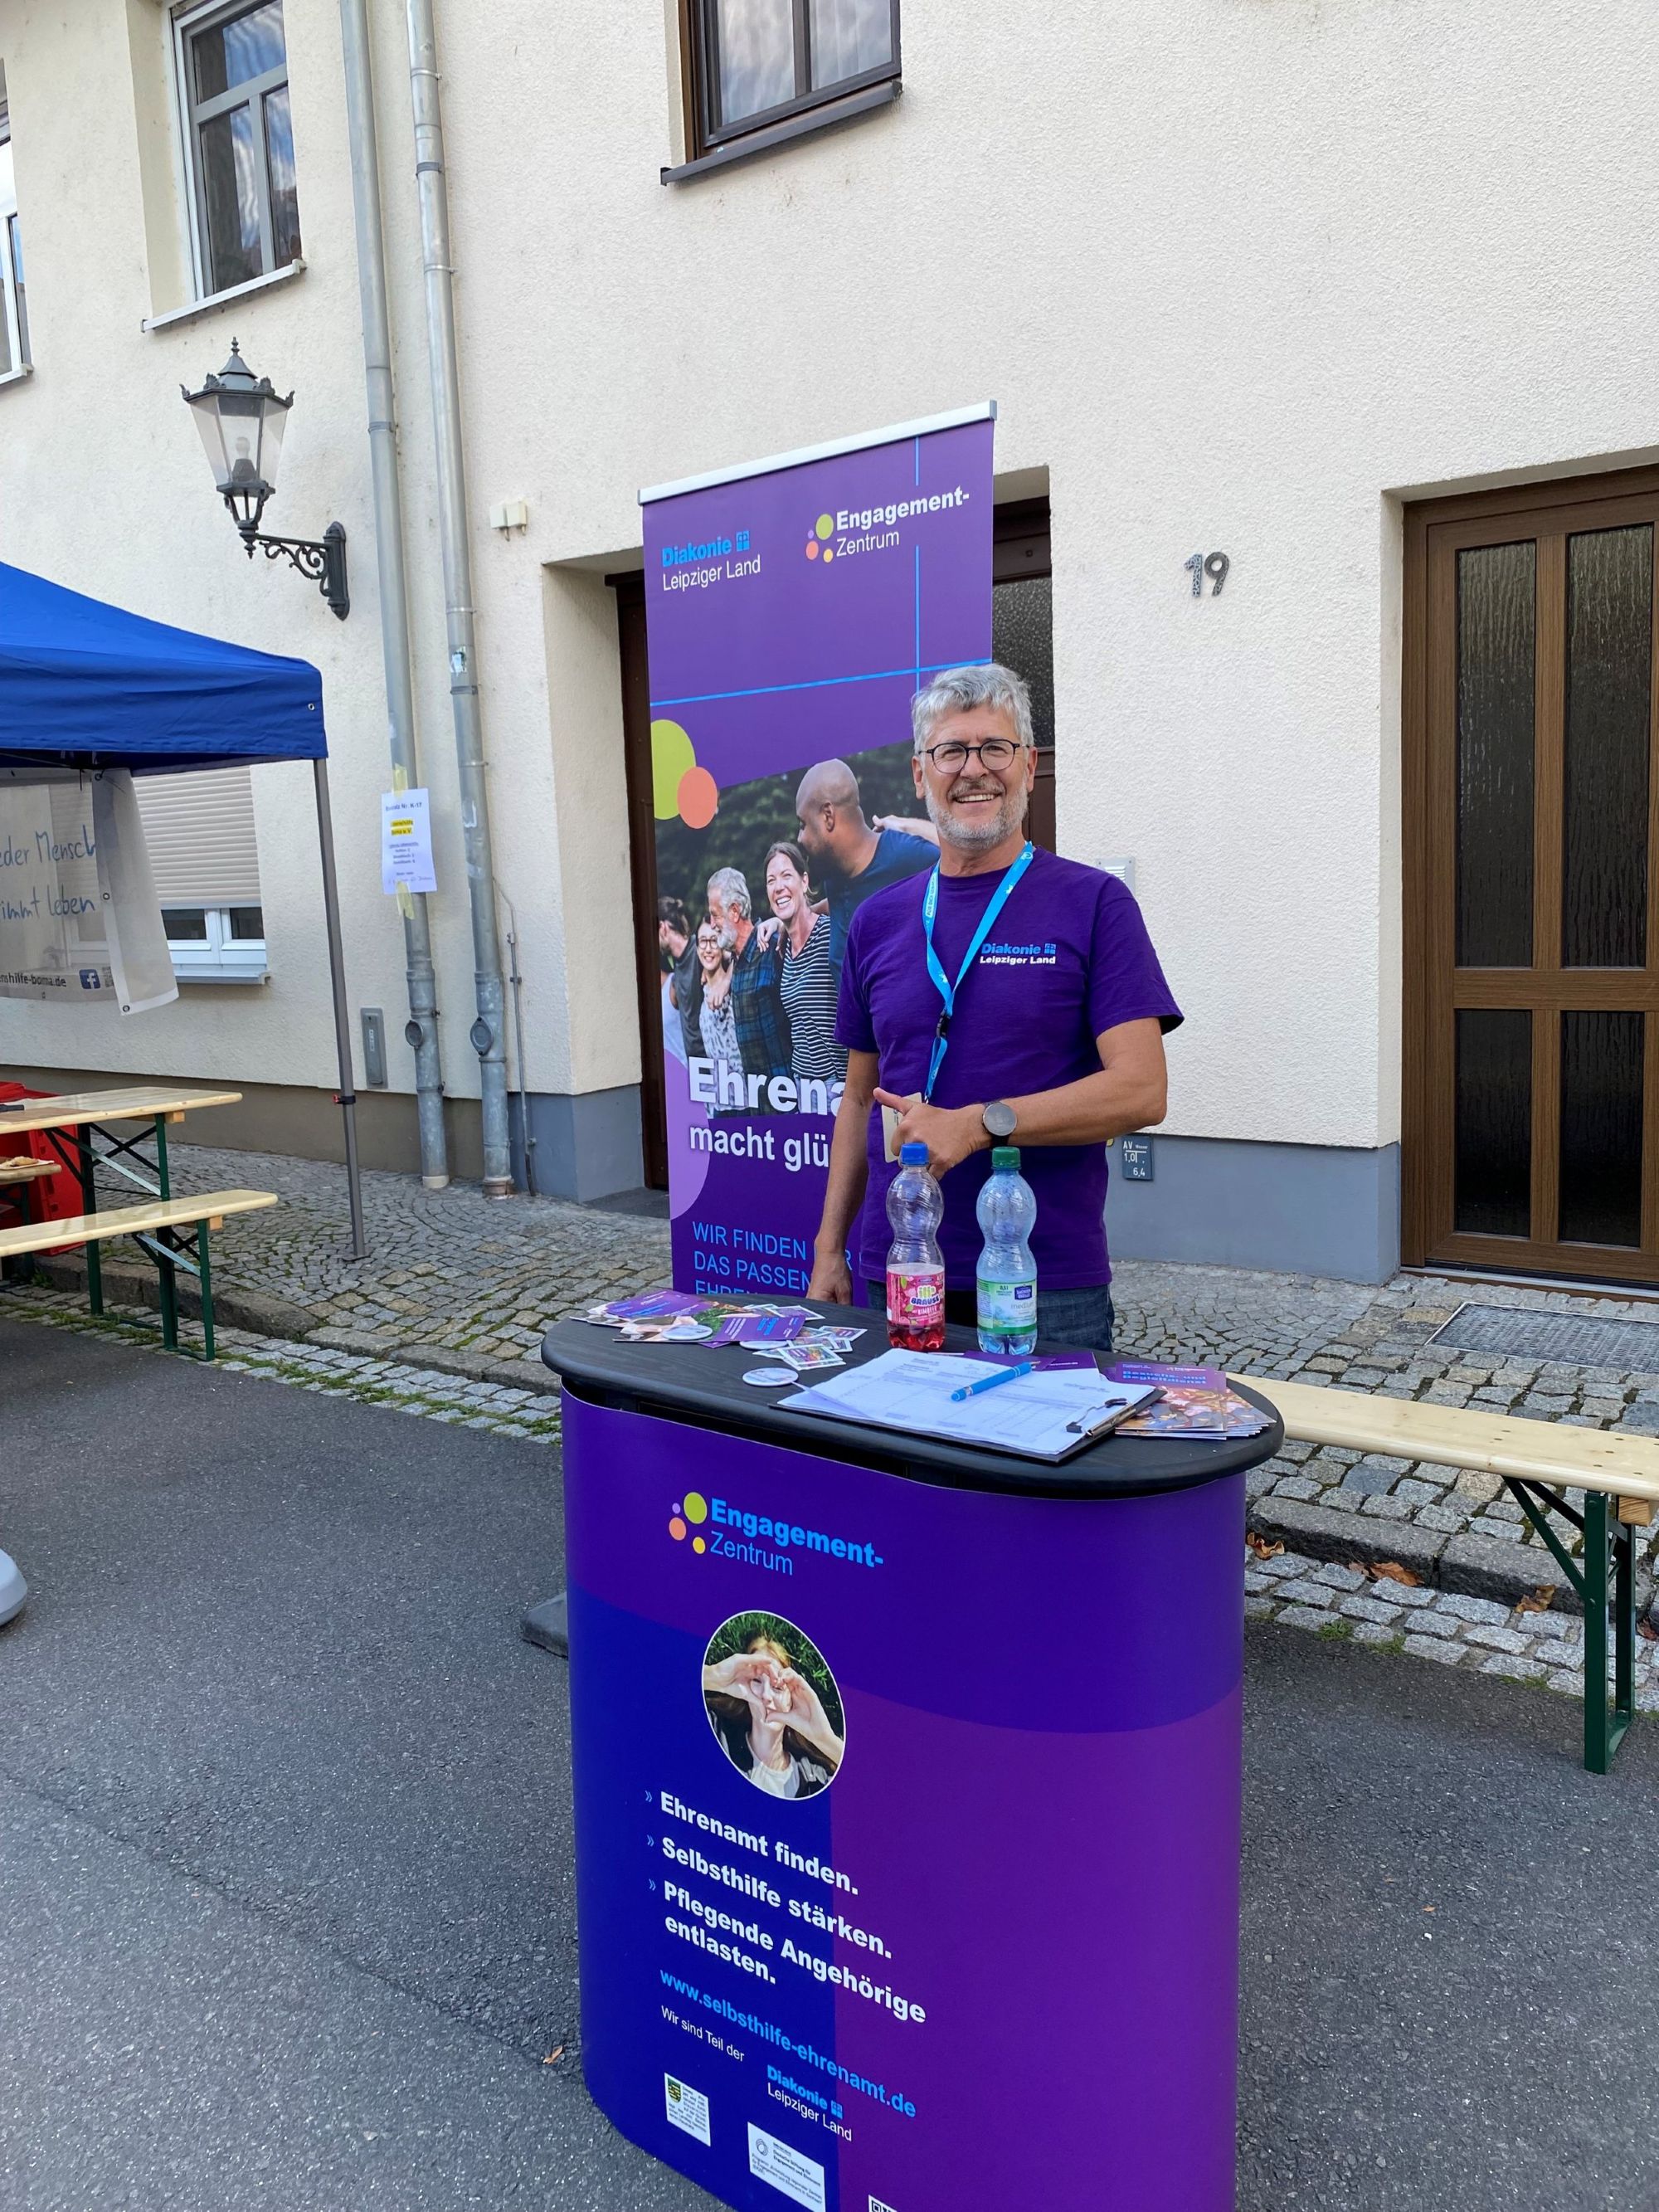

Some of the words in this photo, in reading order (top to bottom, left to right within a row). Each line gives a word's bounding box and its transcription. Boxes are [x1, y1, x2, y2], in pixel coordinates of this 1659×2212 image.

[836, 485, 970, 530] Engagement-
[662, 536, 732, 567] Diakonie
[836, 531, 900, 557] Zentrum
[664, 567, 722, 592] Leipziger
[727, 554, 761, 578] Land
[1185, 552, 1229, 597] 19
[35, 824, 95, 864] Mensch
[47, 884, 95, 917] leben
[980, 955, 1028, 965] Leipziger
[1029, 956, 1056, 964] Land
[981, 943, 1042, 954] Diakonie
[689, 1126, 776, 1160] macht
[693, 1221, 727, 1246] WIR
[733, 1229, 806, 1260] FINDEN
[694, 1251, 731, 1275] DAS
[710, 1530, 793, 1576] Zentrum
[711, 1497, 883, 1567] Engagement-
[660, 1791, 768, 1856] Ehrenamt
[774, 1842, 859, 1895] finden.
[662, 1836, 781, 1907] Selbsthilfe
[788, 1897, 892, 1959] stärken.
[664, 1916, 776, 1985] entlasten.
[664, 1880, 774, 1950] Pflegende
[780, 1938, 926, 2023] Angehörige
[659, 1970, 917, 2118] www.selbsthilfe-ehrenamt.de
[661, 2005, 679, 2024] Wir
[681, 2020, 703, 2039] sind
[705, 2029, 723, 2052] Teil
[726, 2044, 745, 2062] der
[767, 2064, 828, 2110] Diakonie
[767, 2082, 820, 2122] Leipziger
[822, 2112, 853, 2142] Land
